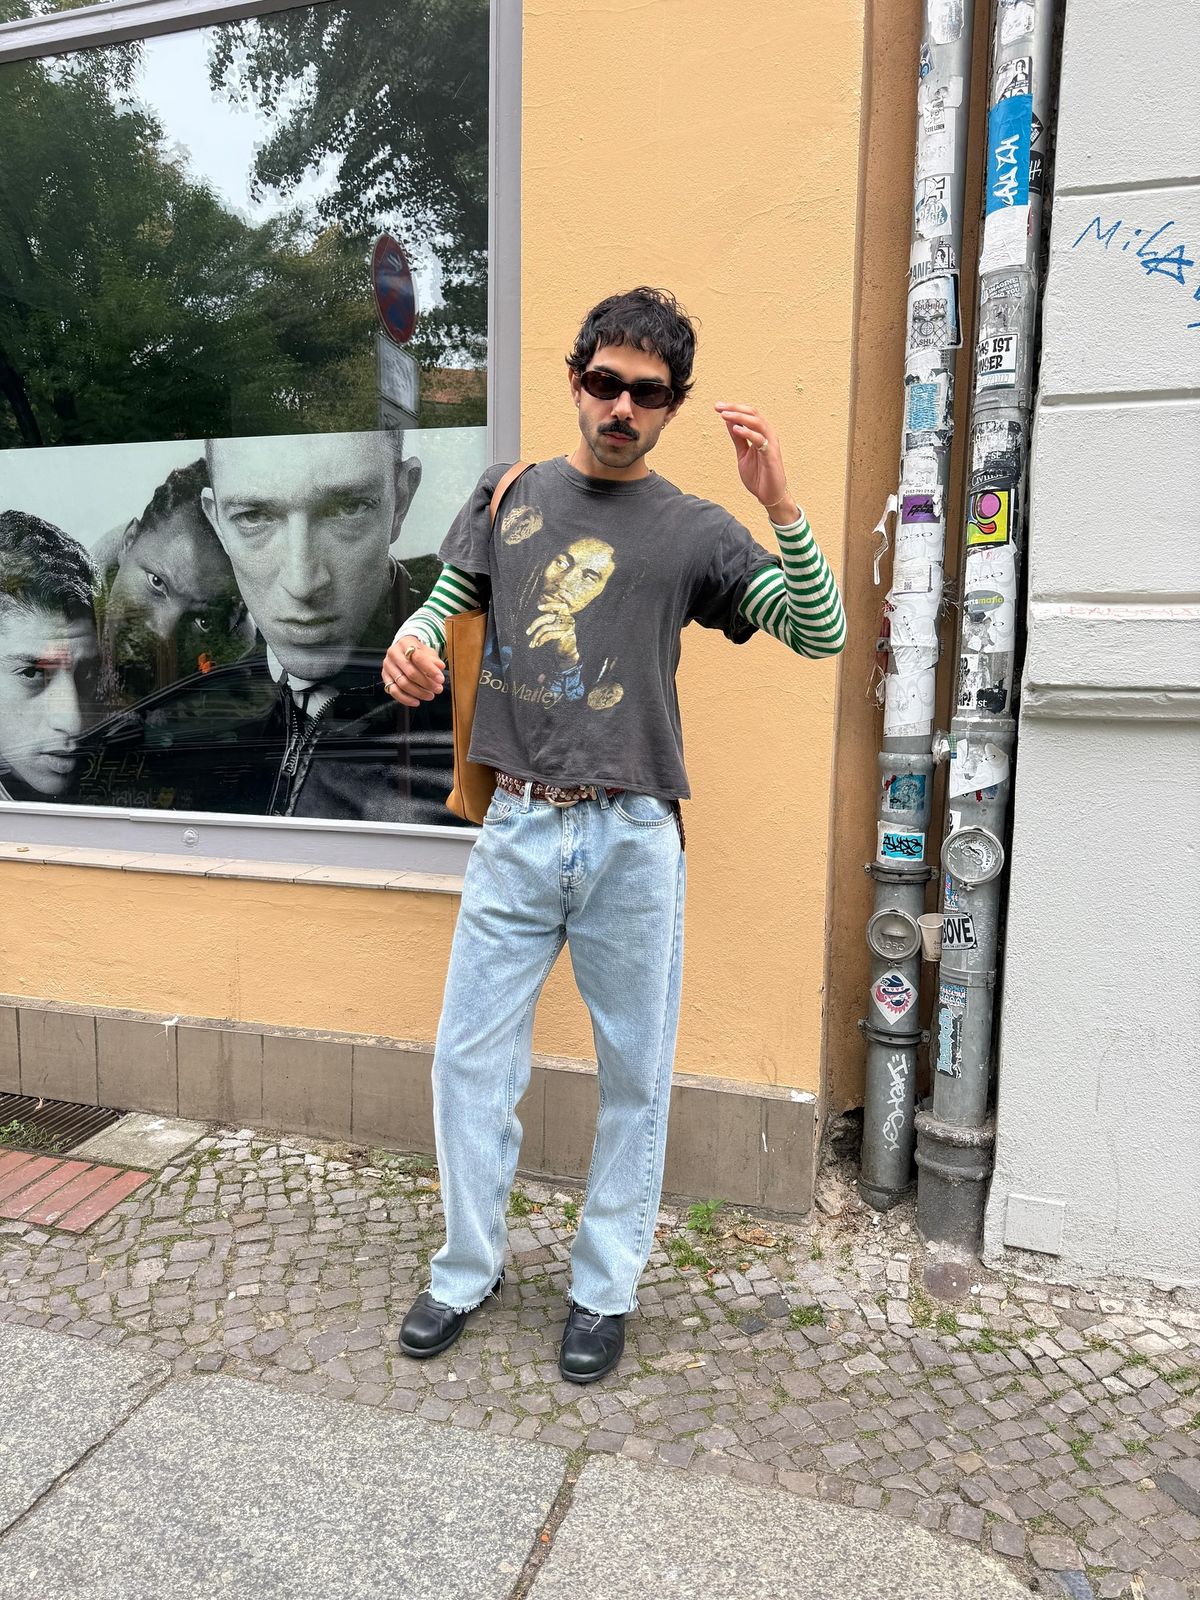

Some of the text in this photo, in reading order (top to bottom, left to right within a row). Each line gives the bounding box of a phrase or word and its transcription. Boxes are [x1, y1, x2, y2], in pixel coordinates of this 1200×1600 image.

[992, 337, 1013, 352] IST
[479, 669, 564, 709] Bob Marley
